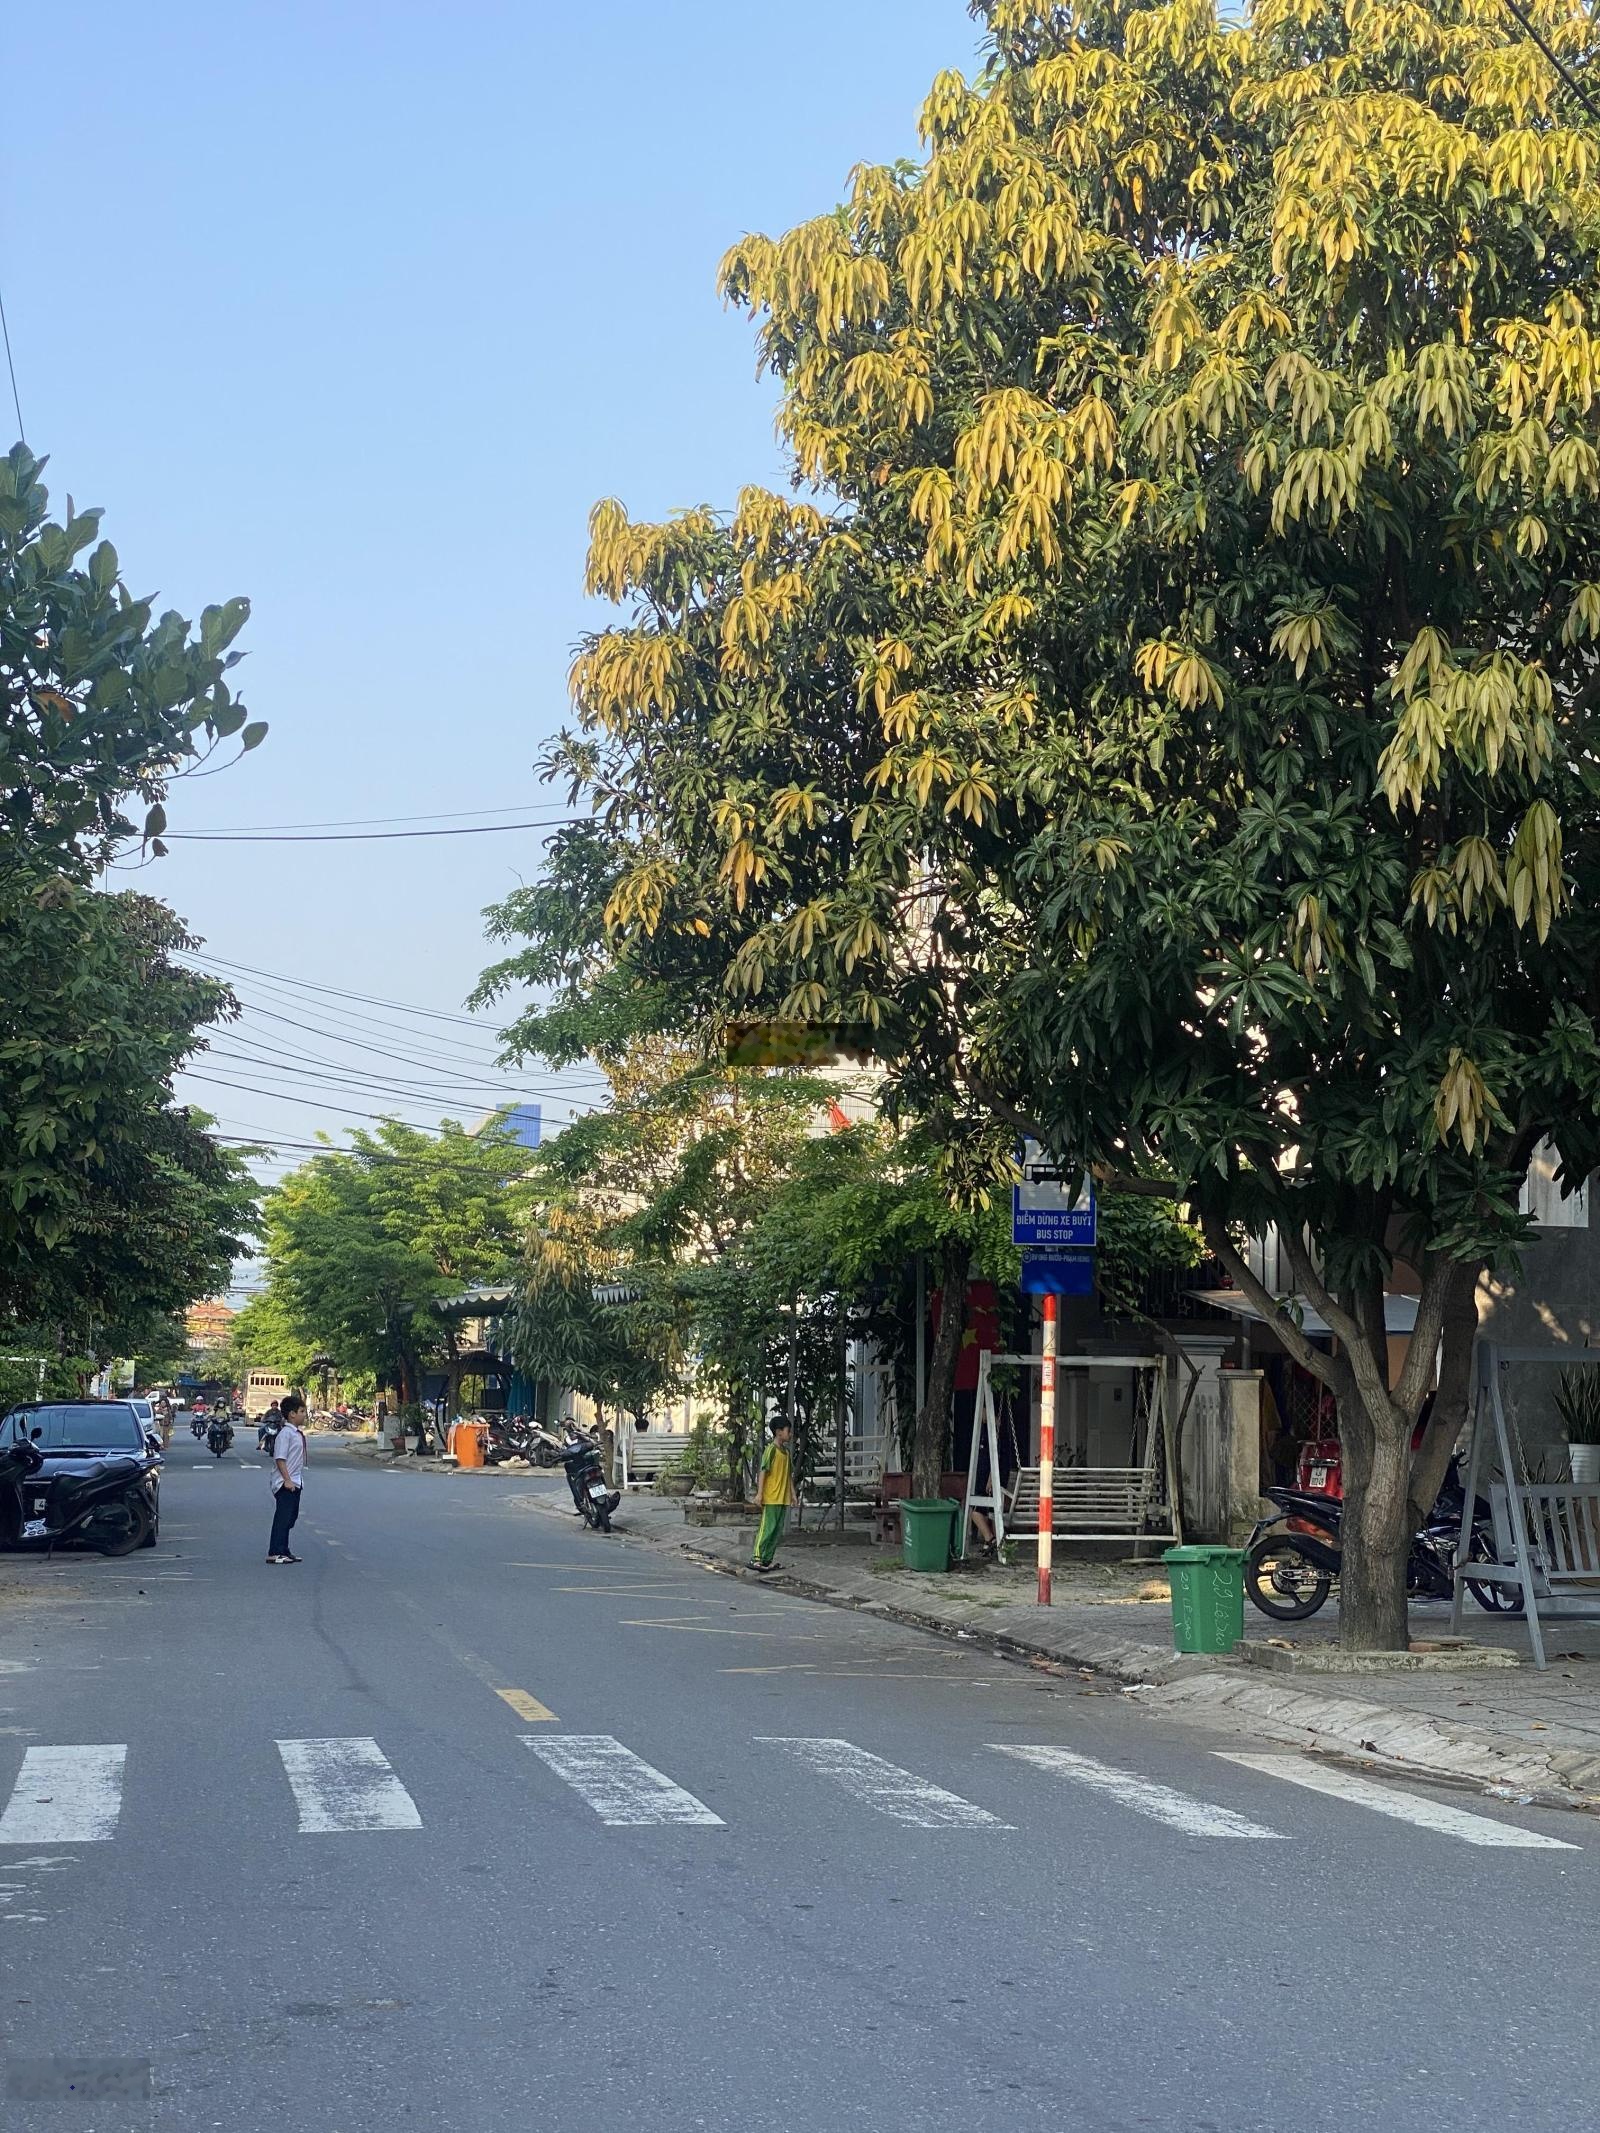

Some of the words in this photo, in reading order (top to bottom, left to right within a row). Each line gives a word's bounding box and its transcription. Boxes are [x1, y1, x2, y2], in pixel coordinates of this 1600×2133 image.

[1016, 1211, 1035, 1225] ĐIỂM
[1037, 1212, 1059, 1225] DỪNG
[1060, 1215, 1070, 1225] XE
[1072, 1212, 1092, 1226] BUÝT
[1036, 1229, 1052, 1239] BUS
[1053, 1229, 1073, 1240] STOP
[1212, 1570, 1234, 1598] 29
